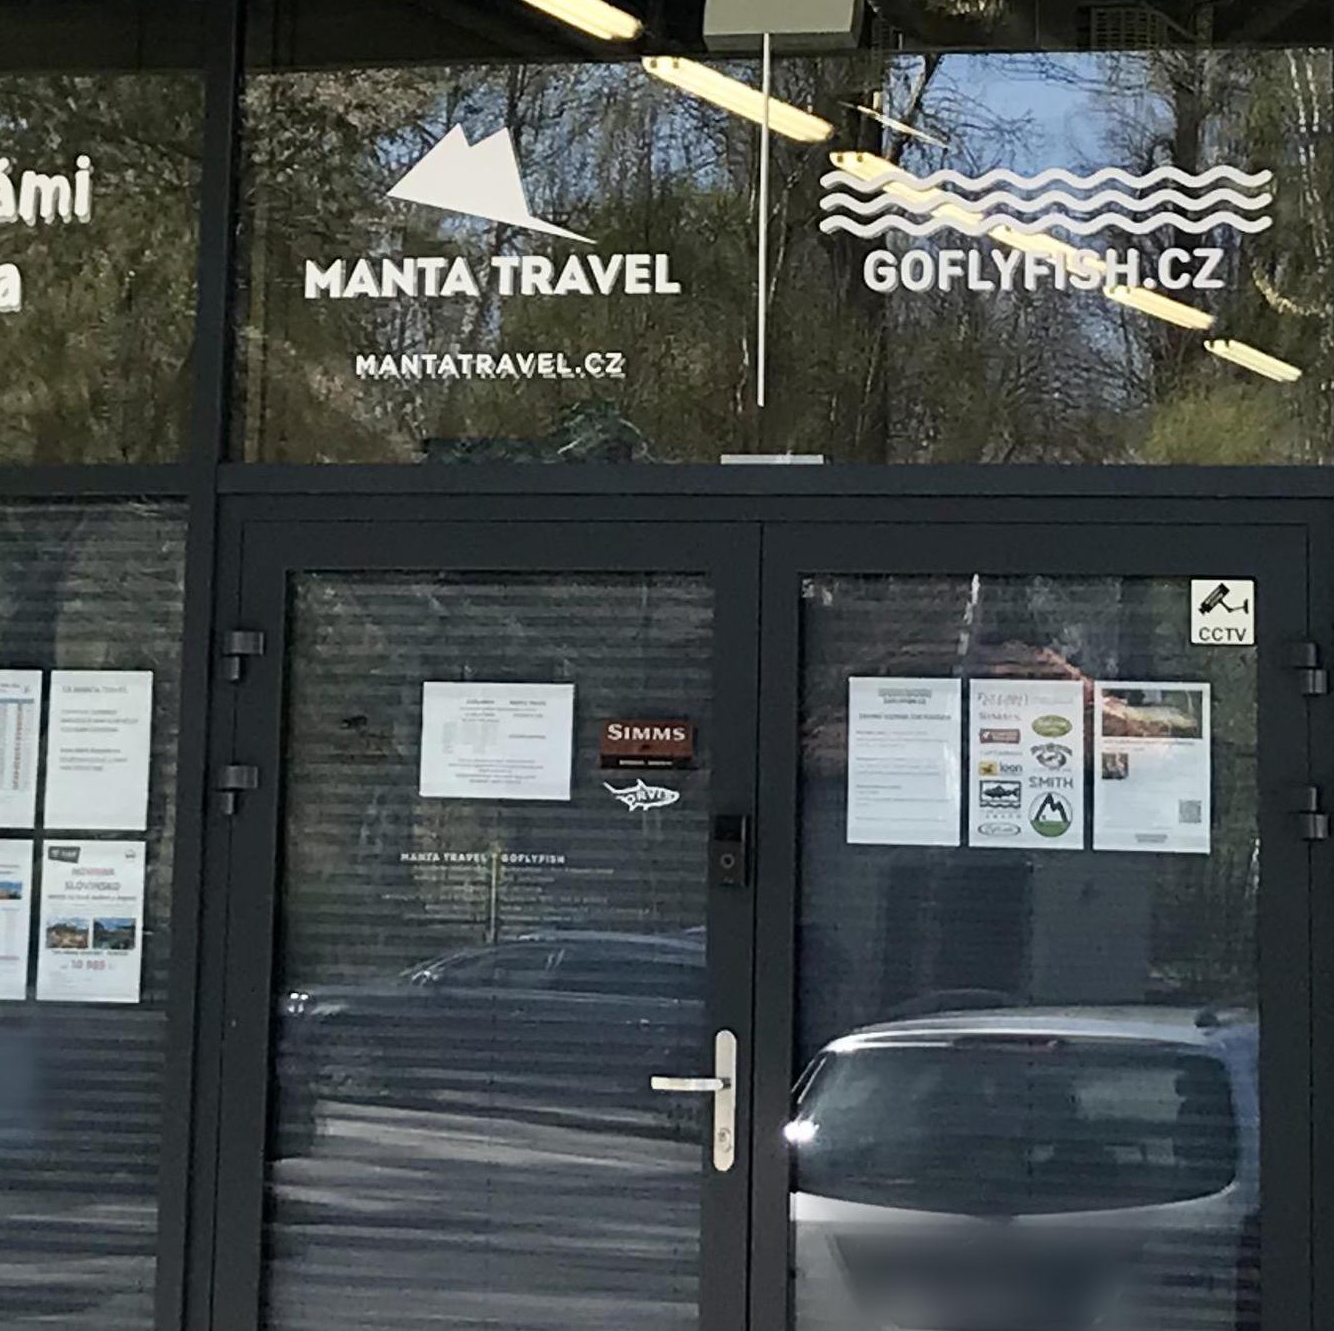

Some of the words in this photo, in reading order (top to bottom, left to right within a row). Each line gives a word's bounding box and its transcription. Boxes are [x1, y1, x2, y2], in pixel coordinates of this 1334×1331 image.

[304, 255, 471, 300] MANTA
[492, 253, 682, 297] TRAVEL
[862, 248, 1225, 293] GOFLYFISH.CZ
[354, 351, 625, 381] MANTATRAVEL.CZ
[1198, 627, 1247, 642] CCTV
[607, 723, 686, 742] SIMMS
